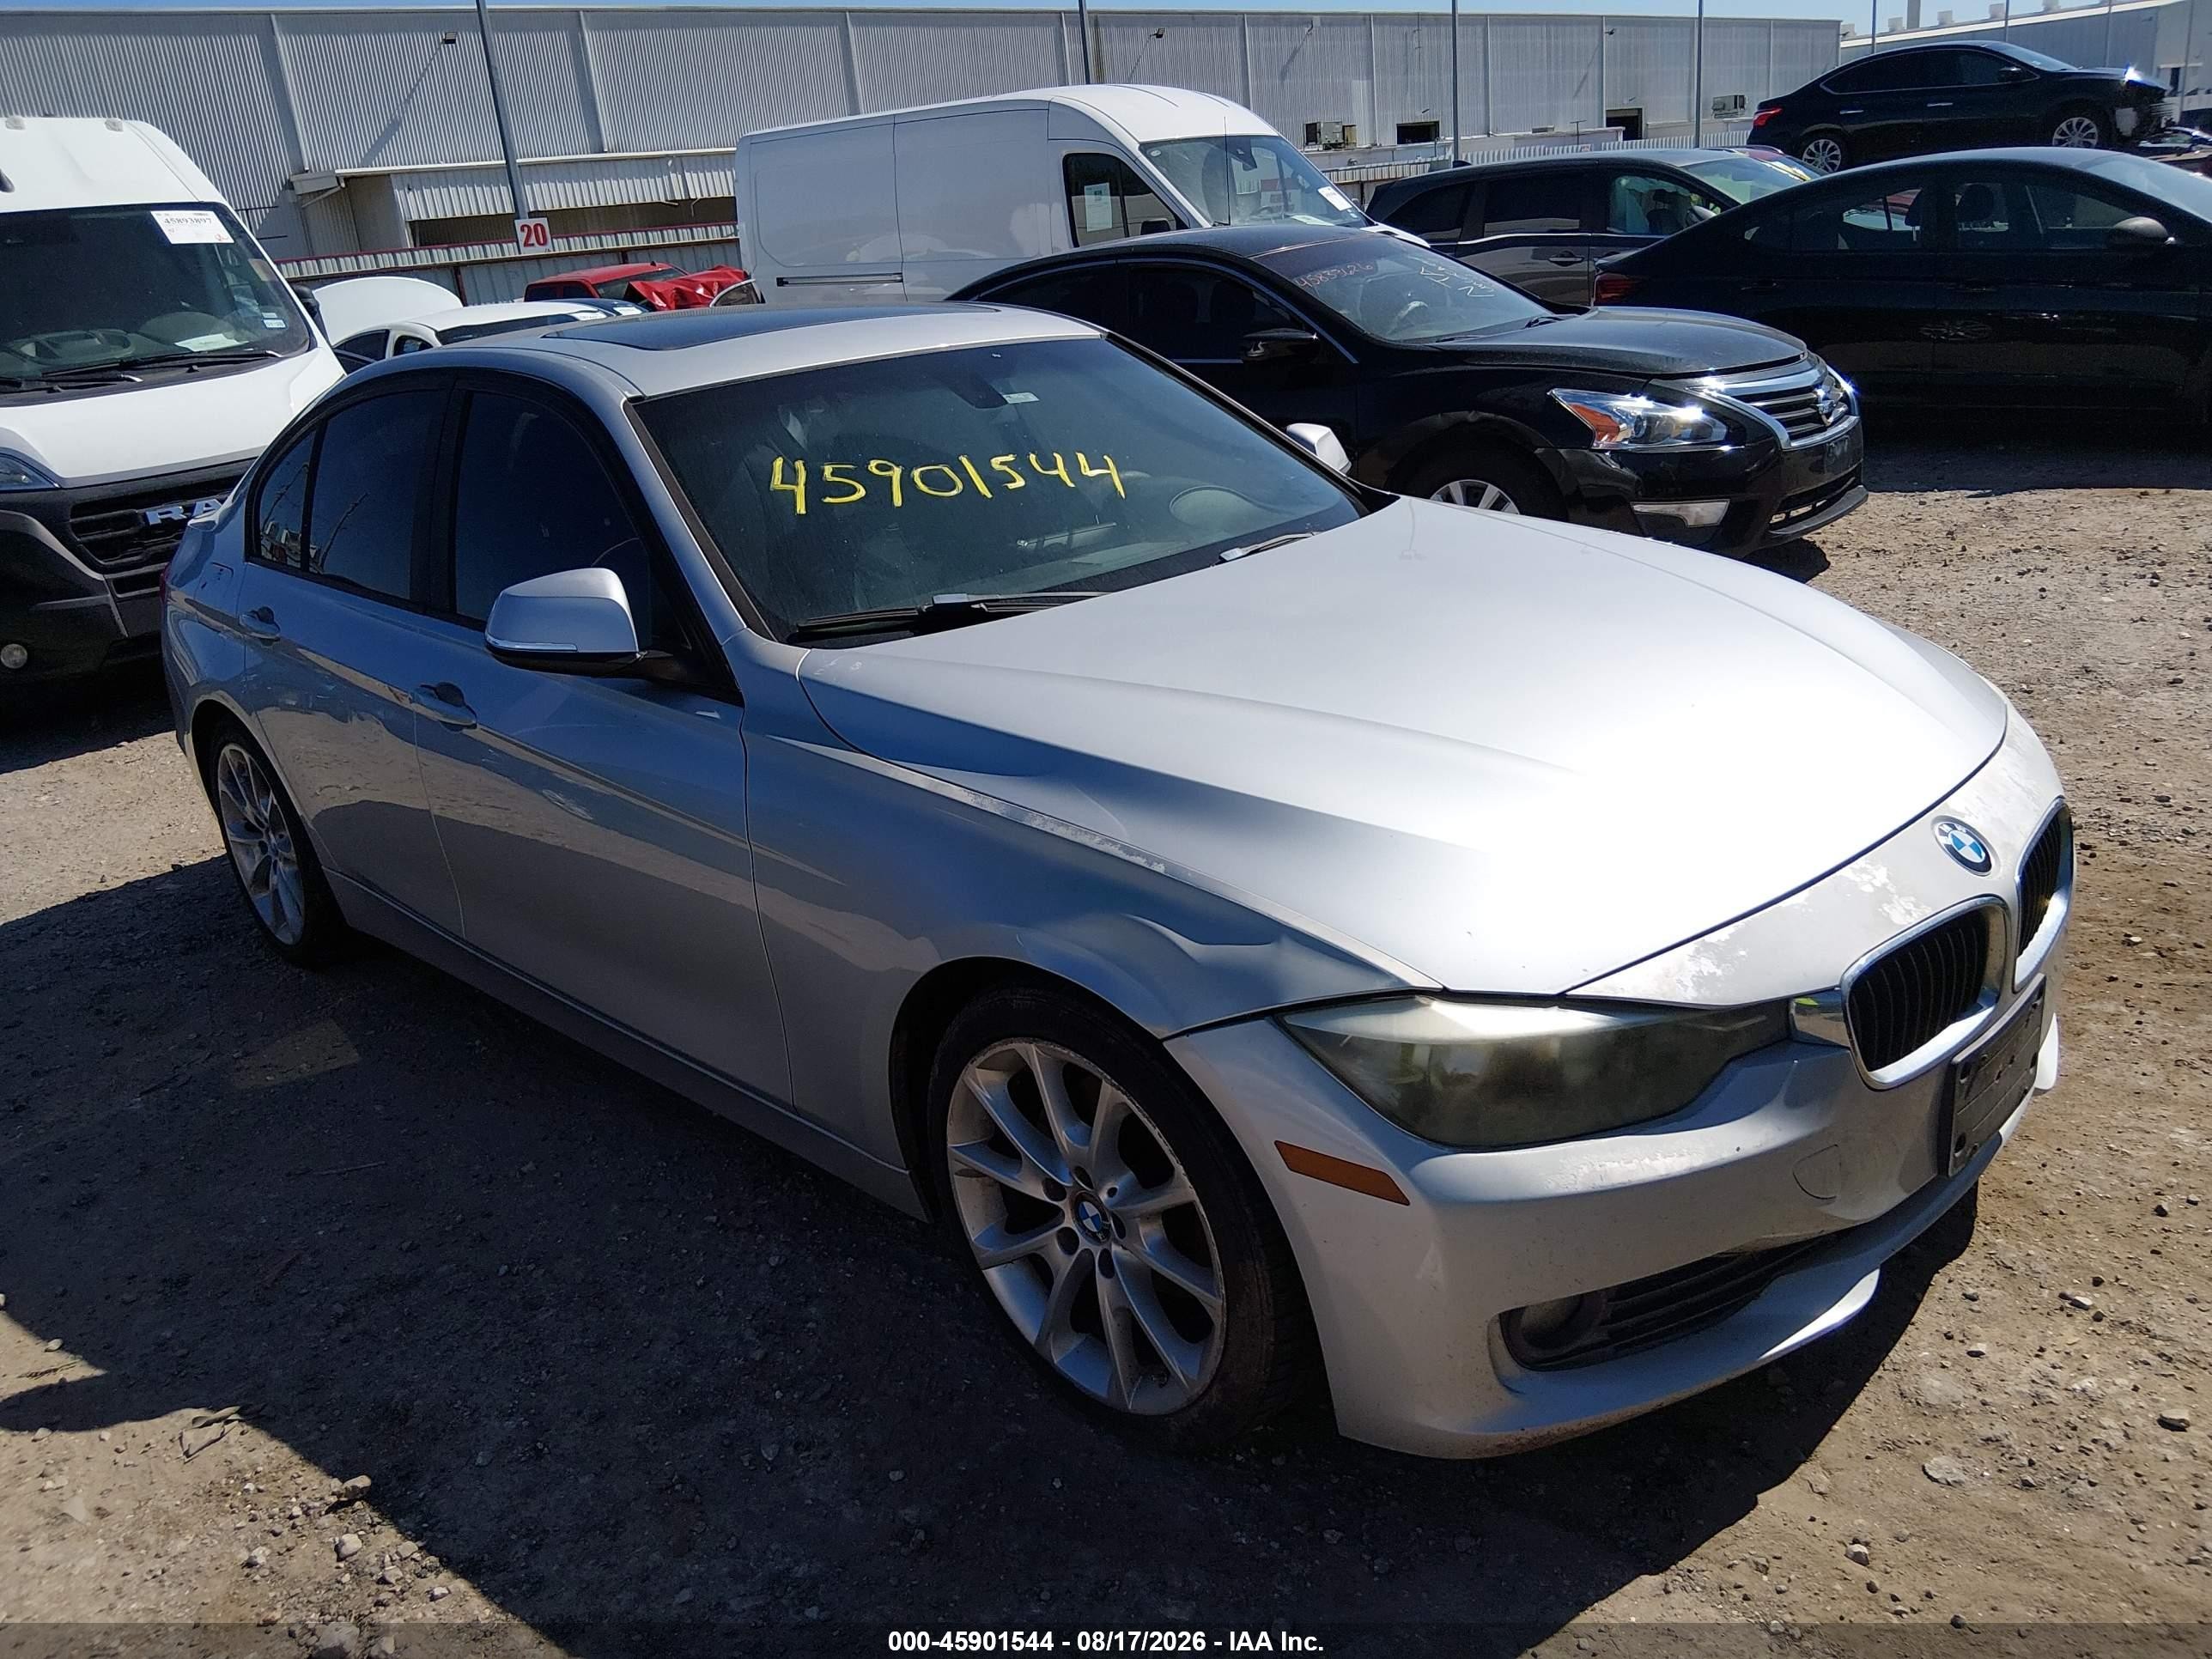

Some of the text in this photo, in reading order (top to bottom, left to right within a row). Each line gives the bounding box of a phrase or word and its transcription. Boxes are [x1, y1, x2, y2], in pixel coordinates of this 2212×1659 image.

[520, 222, 548, 247] 20
[770, 453, 1126, 514] 45901544
[145, 499, 224, 526] RA
